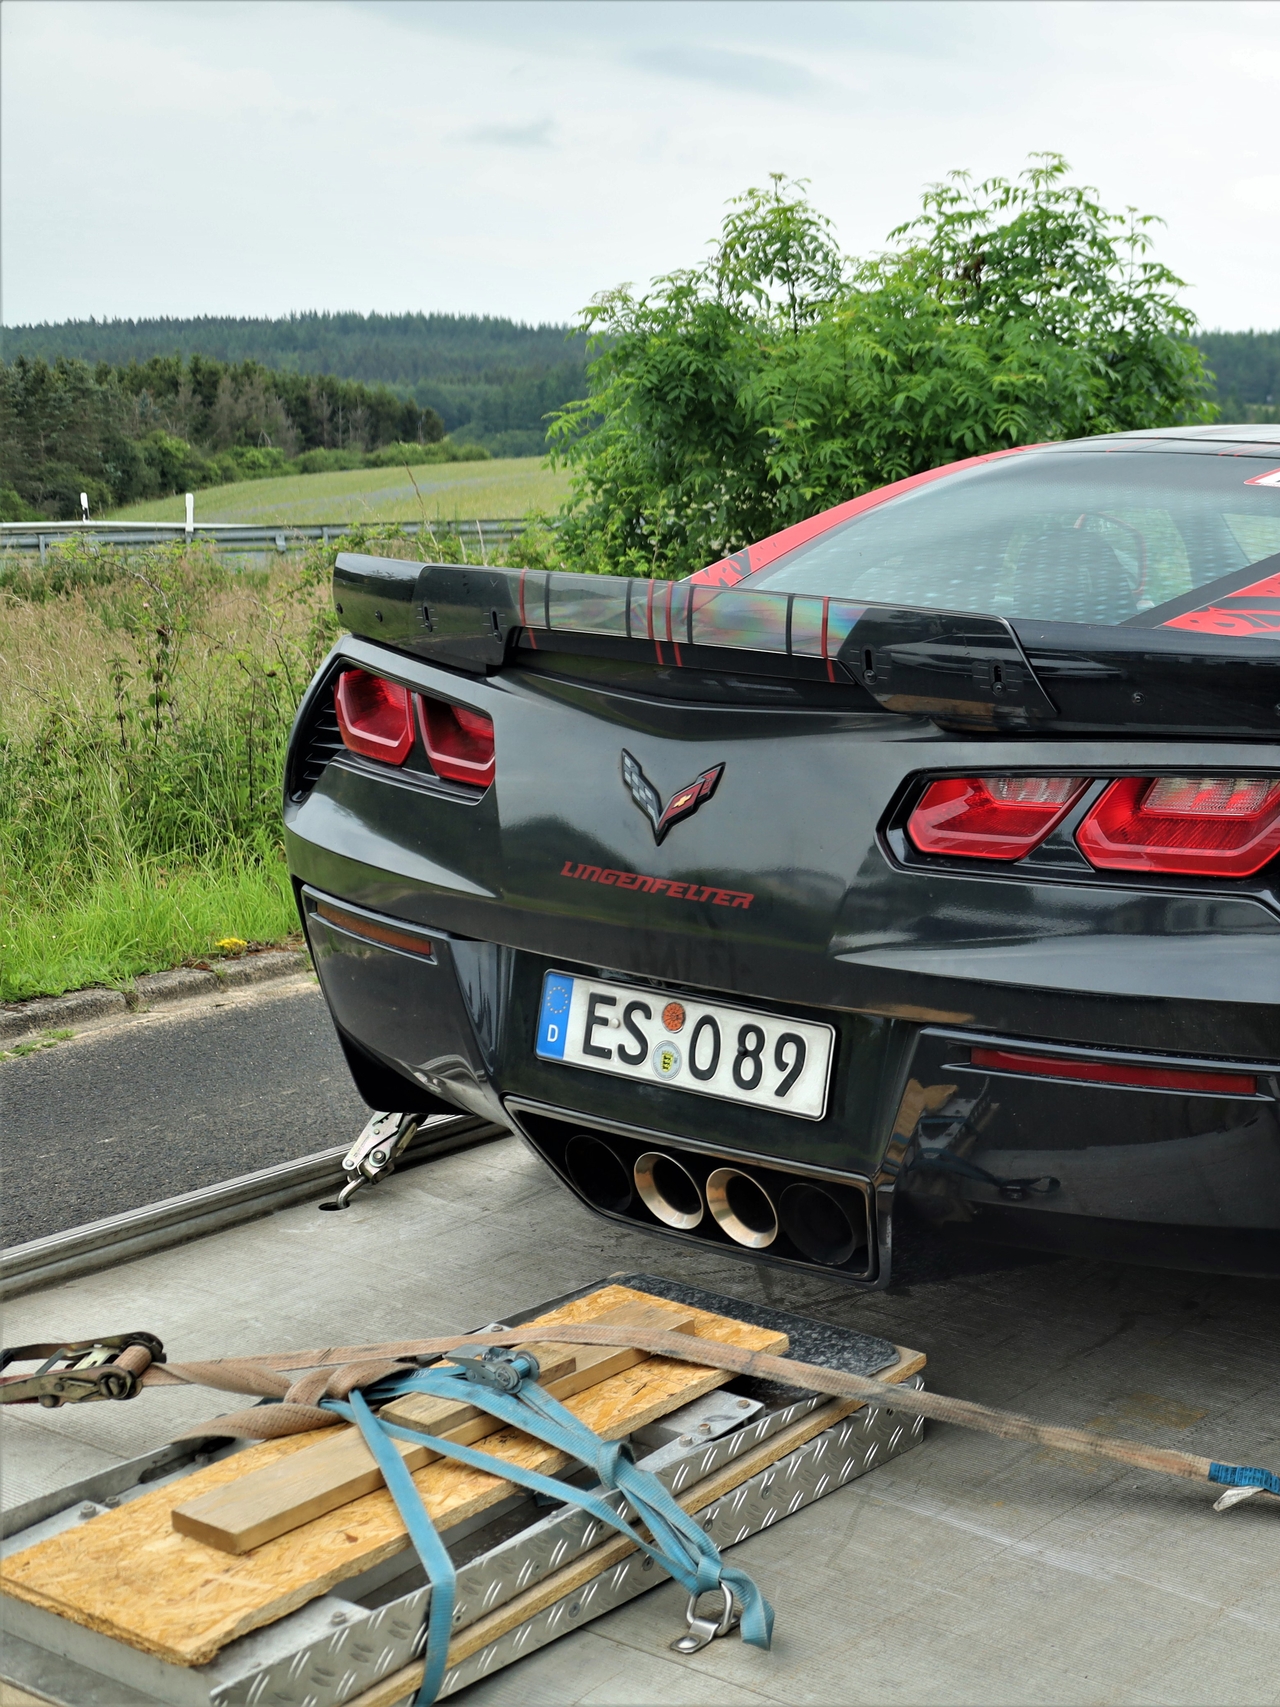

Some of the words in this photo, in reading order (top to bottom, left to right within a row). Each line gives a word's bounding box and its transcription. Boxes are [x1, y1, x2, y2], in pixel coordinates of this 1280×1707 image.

[560, 860, 755, 909] LINGENFELTER
[546, 1023, 560, 1042] D
[582, 992, 652, 1066] ES
